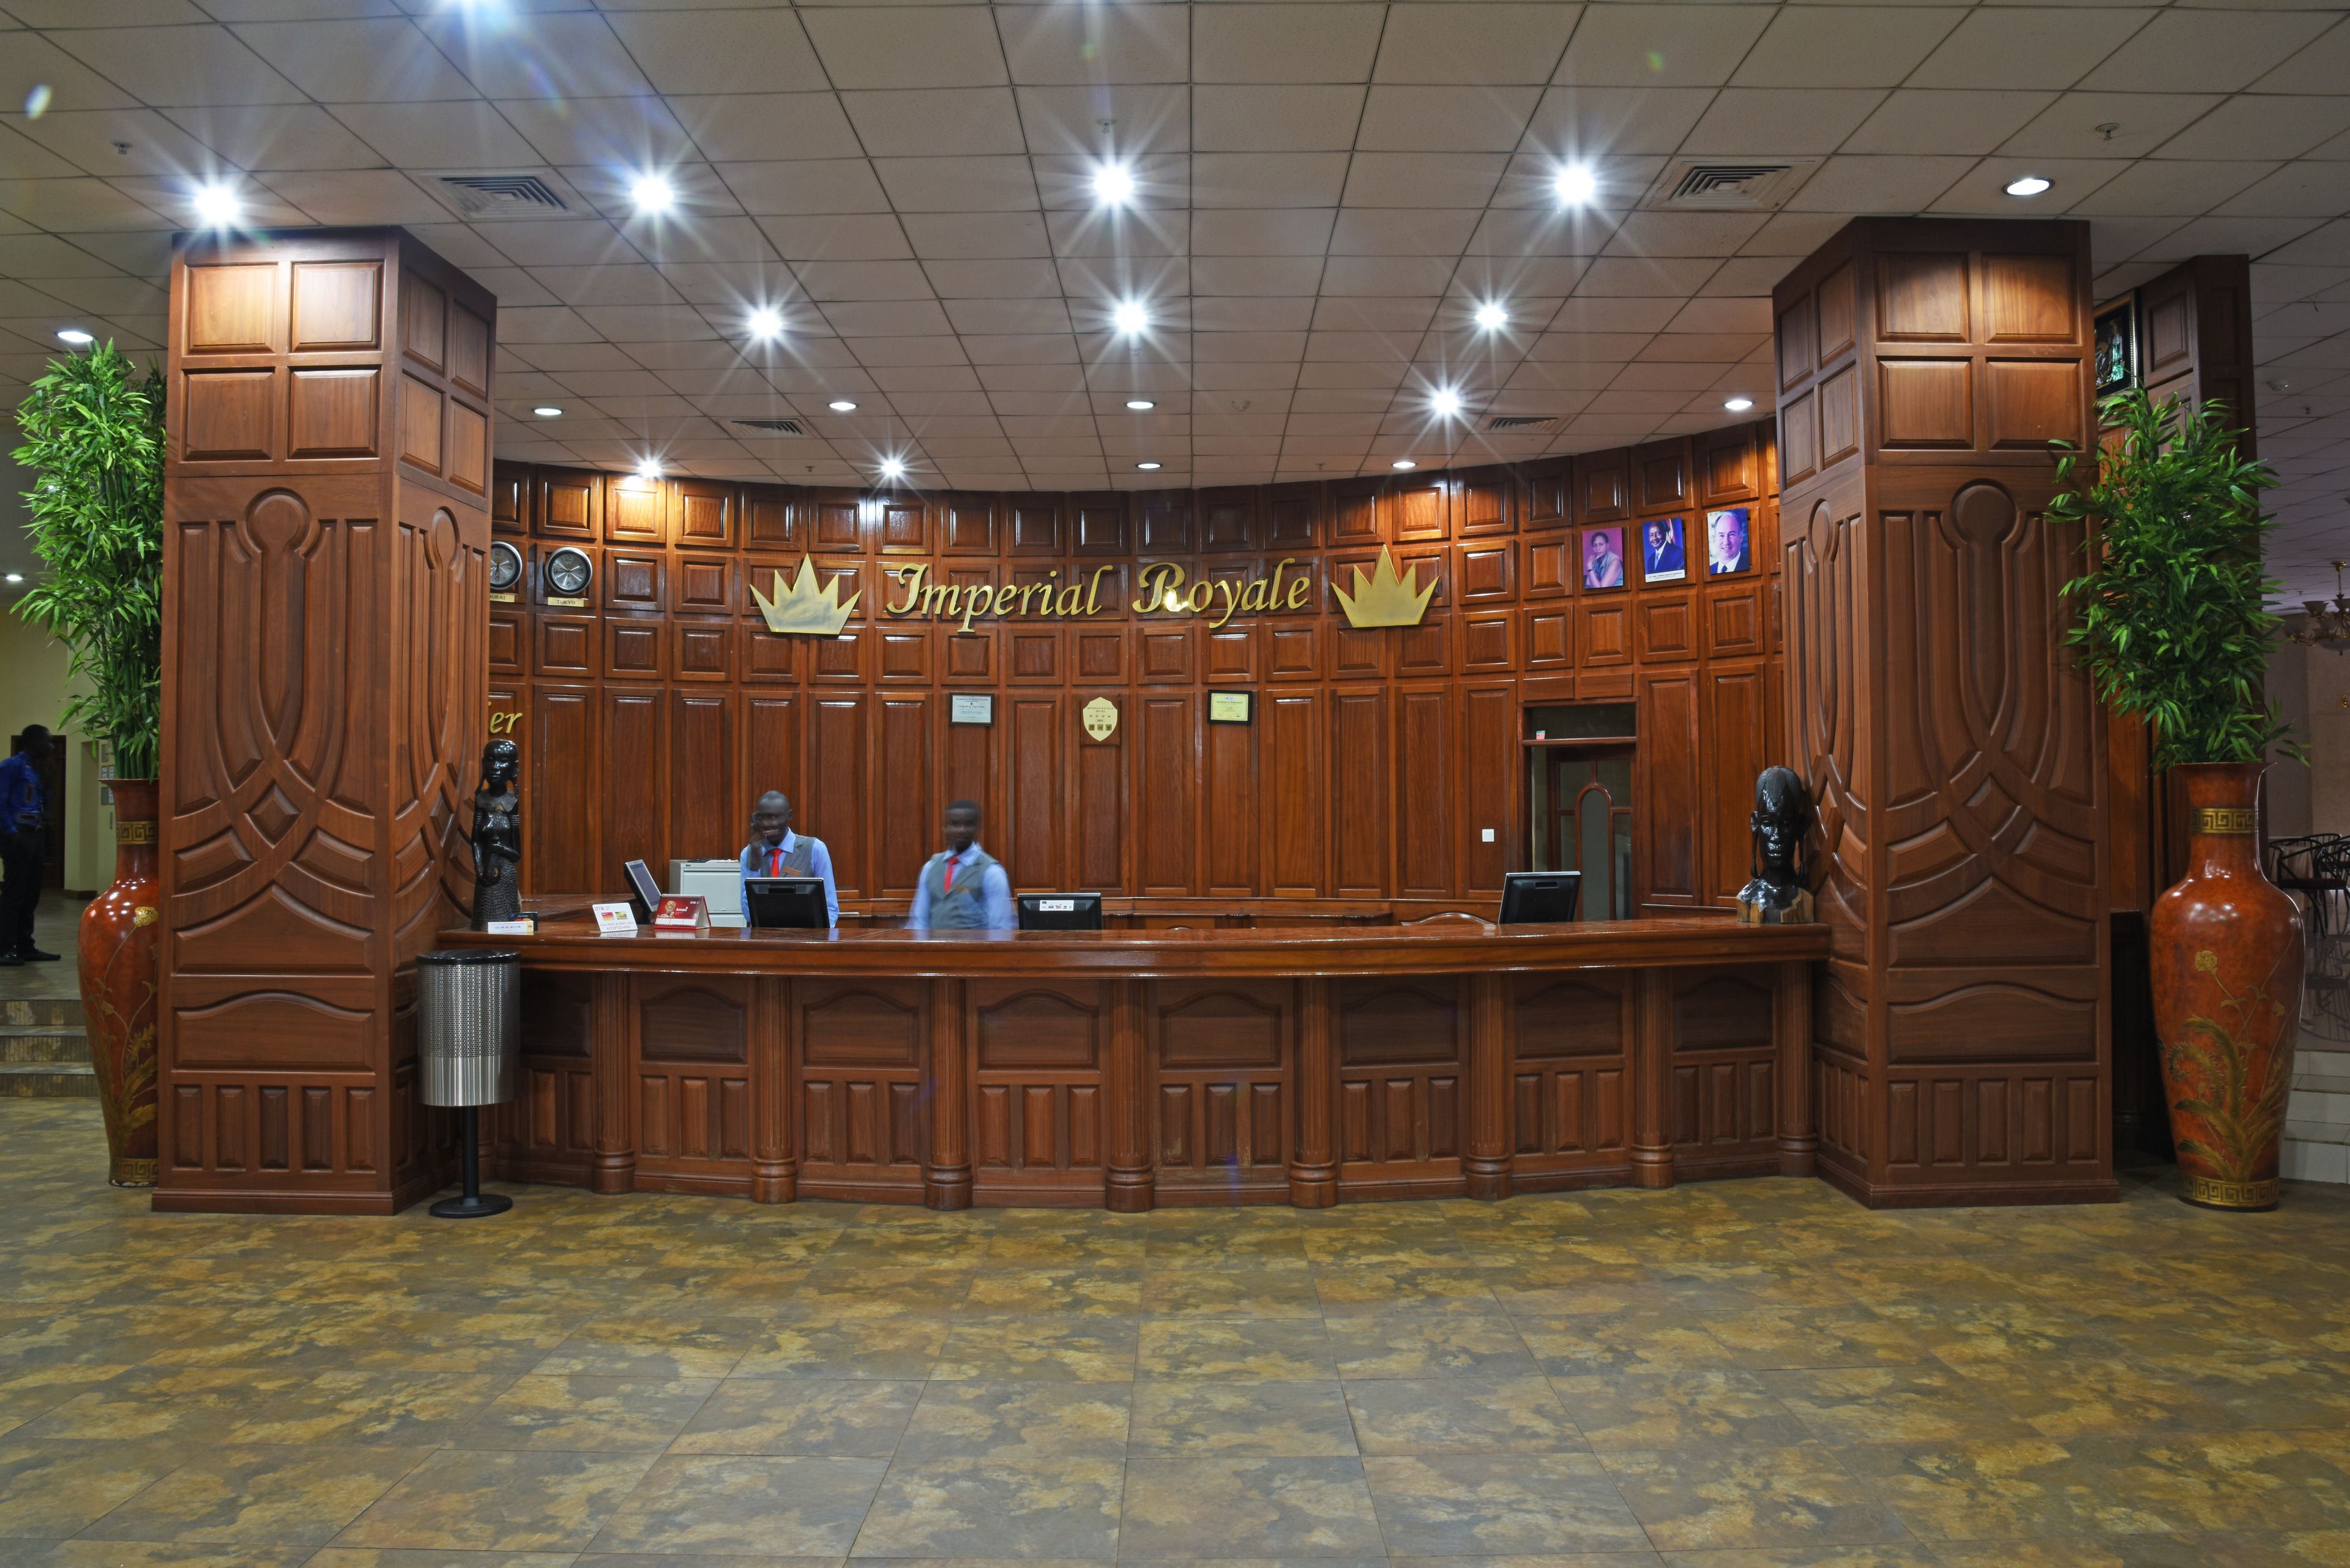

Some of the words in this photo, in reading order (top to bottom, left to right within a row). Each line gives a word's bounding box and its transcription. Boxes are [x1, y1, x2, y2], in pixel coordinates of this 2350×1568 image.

[887, 563, 1113, 632] Imperial
[1132, 558, 1310, 629] Royale
[488, 701, 523, 733] er
